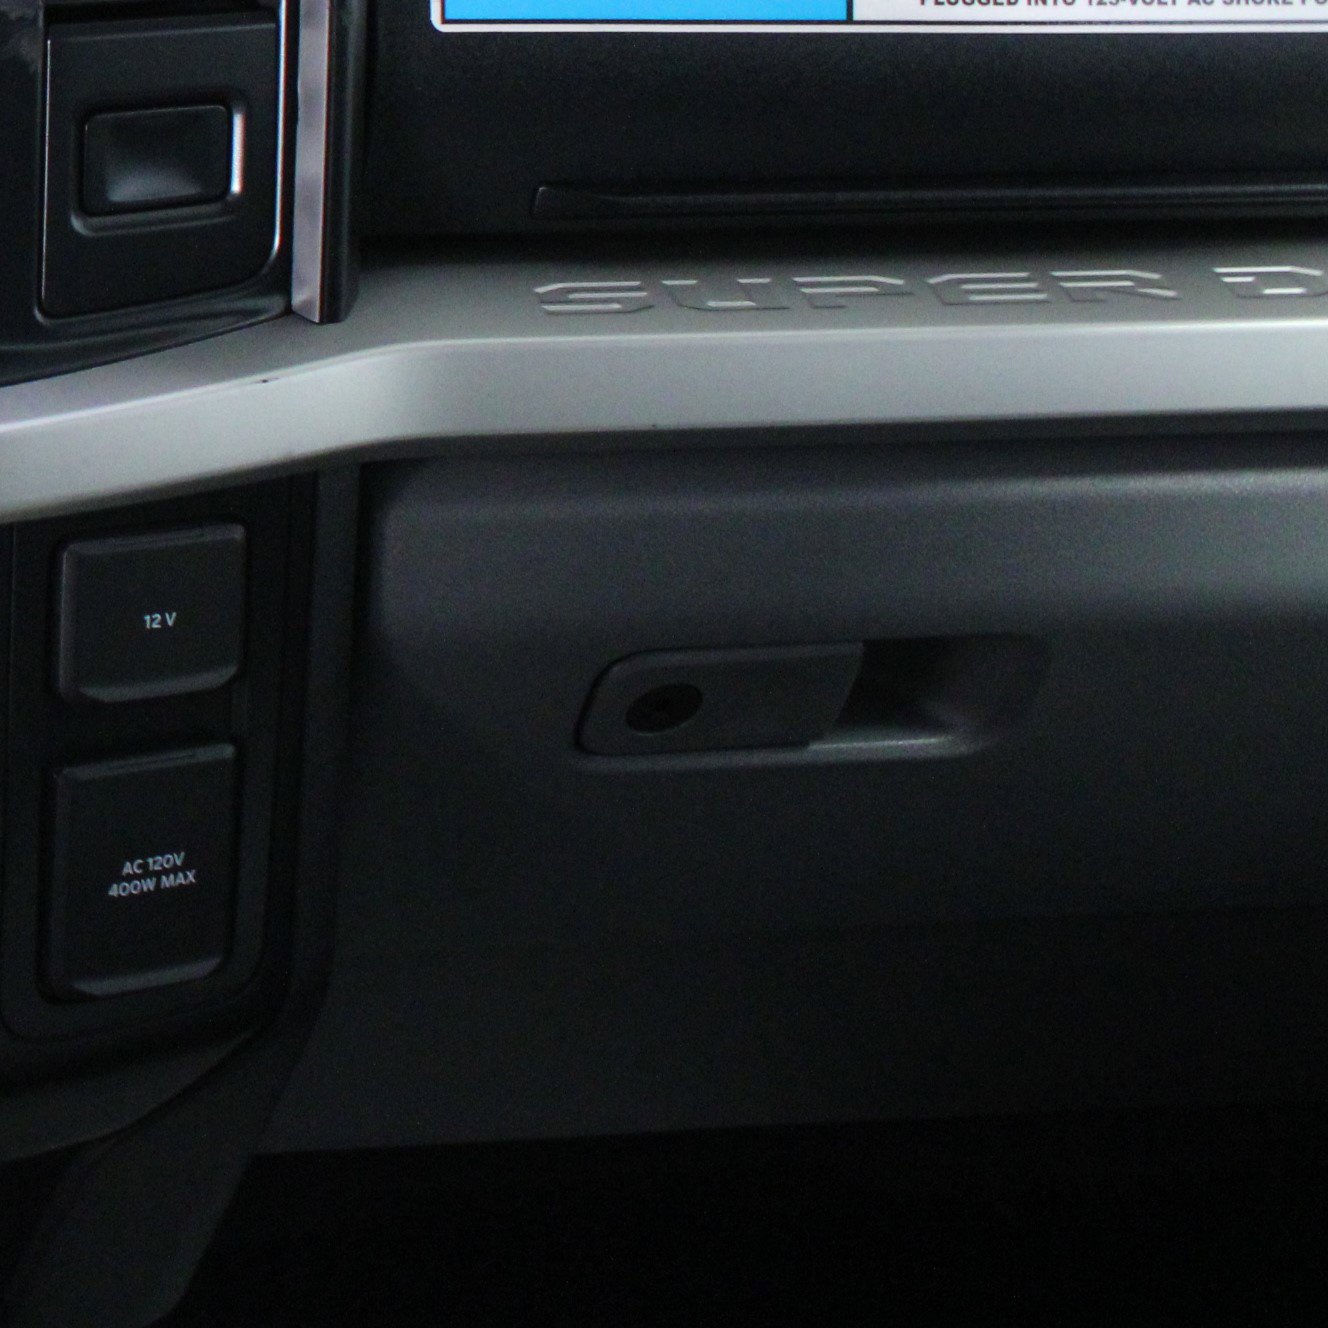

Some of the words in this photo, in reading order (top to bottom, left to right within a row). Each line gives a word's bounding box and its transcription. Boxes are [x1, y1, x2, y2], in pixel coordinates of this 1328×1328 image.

[535, 269, 1182, 314] SUPER
[143, 612, 162, 630] 12
[165, 611, 178, 628] V
[122, 858, 146, 877] AC
[146, 851, 186, 872] 120V
[108, 875, 157, 898] 400W
[160, 869, 197, 890] MAX
